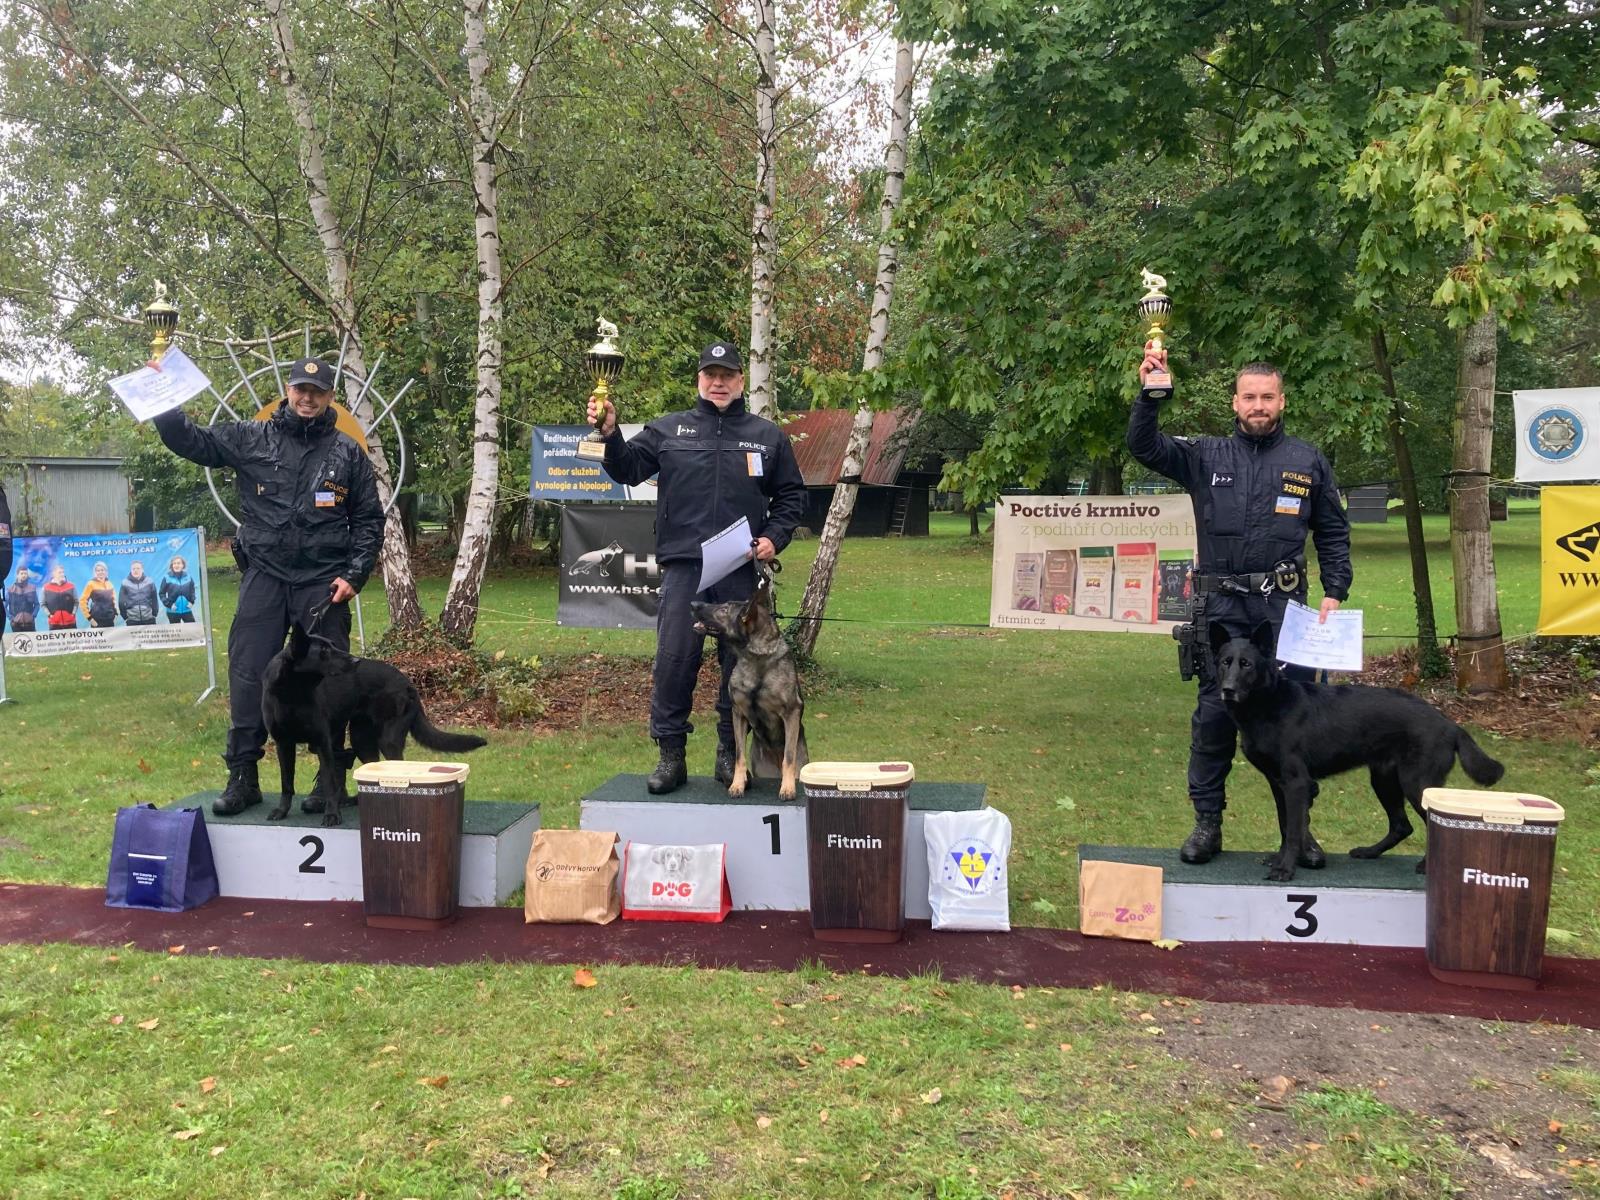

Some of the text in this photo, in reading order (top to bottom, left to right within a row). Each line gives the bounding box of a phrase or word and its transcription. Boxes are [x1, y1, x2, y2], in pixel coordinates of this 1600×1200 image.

[543, 432, 582, 443] Ředitelství
[543, 447, 577, 458] pořádkov
[738, 441, 767, 452] POLICIE
[548, 467, 569, 476] Odbor
[1282, 471, 1312, 484] POLICIE
[323, 480, 349, 495] POLICIE
[535, 481, 571, 492] kynologie
[579, 481, 613, 492] hipologie
[1009, 502, 1160, 518] Poctivé krmivo
[1020, 525, 1029, 535] z
[1099, 521, 1179, 539] Orlických
[1183, 521, 1195, 535] h
[81, 549, 105, 557] SPORT
[624, 553, 659, 578] H
[997, 614, 1047, 625] fitmin.cz
[70, 630, 104, 640] HOTOVY
[372, 826, 421, 842] Fitmin
[762, 813, 782, 855] 1
[827, 833, 882, 849] Fitmin
[298, 834, 326, 873] 2
[577, 865, 601, 873] HOTOVY
[1463, 867, 1529, 888] Fitmin
[1285, 894, 1318, 937] 3
